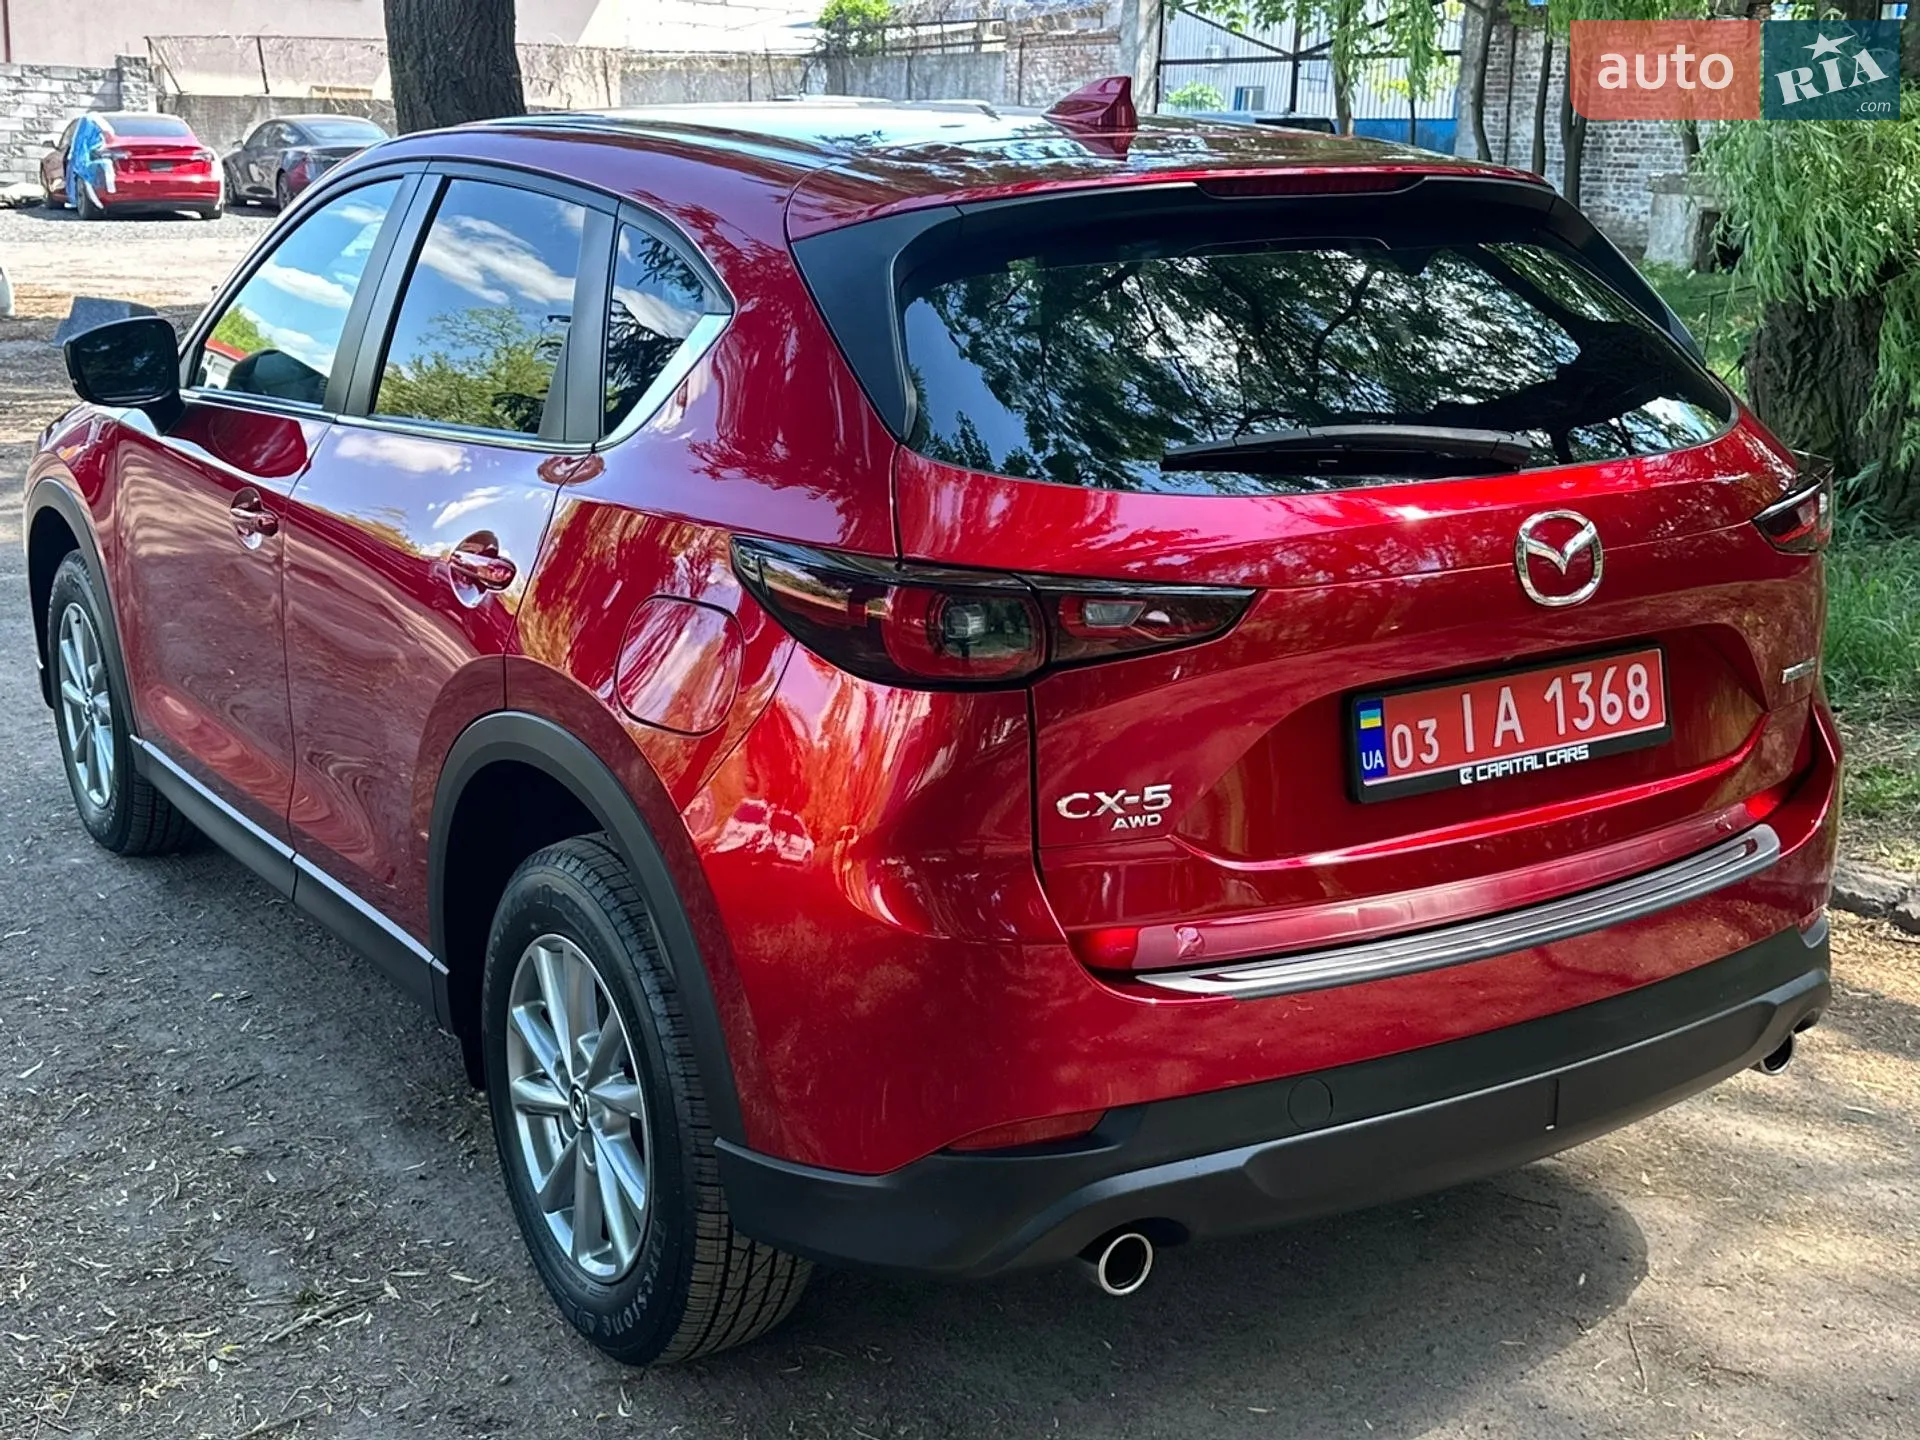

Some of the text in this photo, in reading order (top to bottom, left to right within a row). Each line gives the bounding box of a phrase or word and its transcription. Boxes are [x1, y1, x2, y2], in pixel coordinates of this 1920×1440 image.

[1391, 663, 1651, 769] 03 IA 1368
[1362, 750, 1385, 771] UA
[1476, 744, 1589, 782] CAPITAL CARS
[1056, 783, 1172, 819] CX-5
[1110, 813, 1162, 832] AWD
